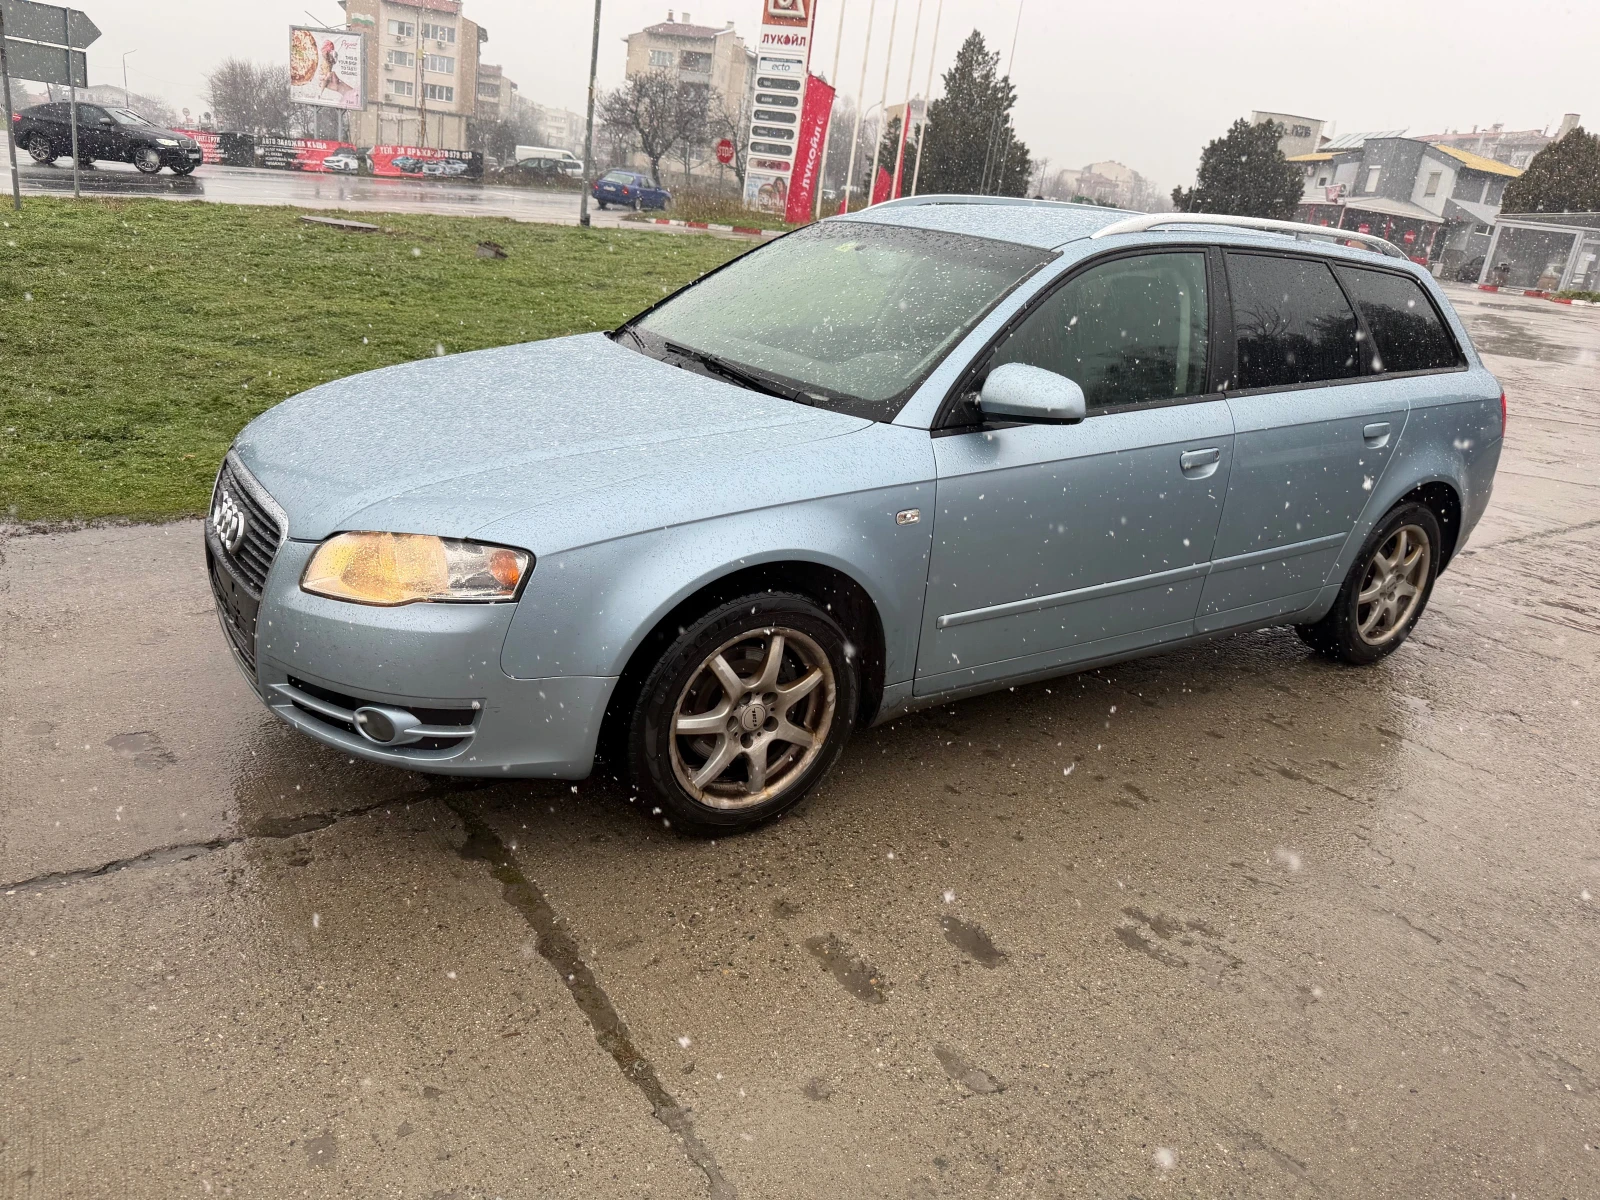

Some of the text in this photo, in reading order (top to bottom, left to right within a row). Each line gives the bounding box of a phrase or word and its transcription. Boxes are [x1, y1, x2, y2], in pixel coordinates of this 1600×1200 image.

[762, 33, 807, 47] ЛУКОЙЛ
[772, 63, 791, 71] ecto
[306, 141, 328, 149] КЪЩА
[397, 147, 405, 155] ЗА
[717, 146, 733, 157] STOP
[801, 126, 822, 190] ЛУКОЙЛ
